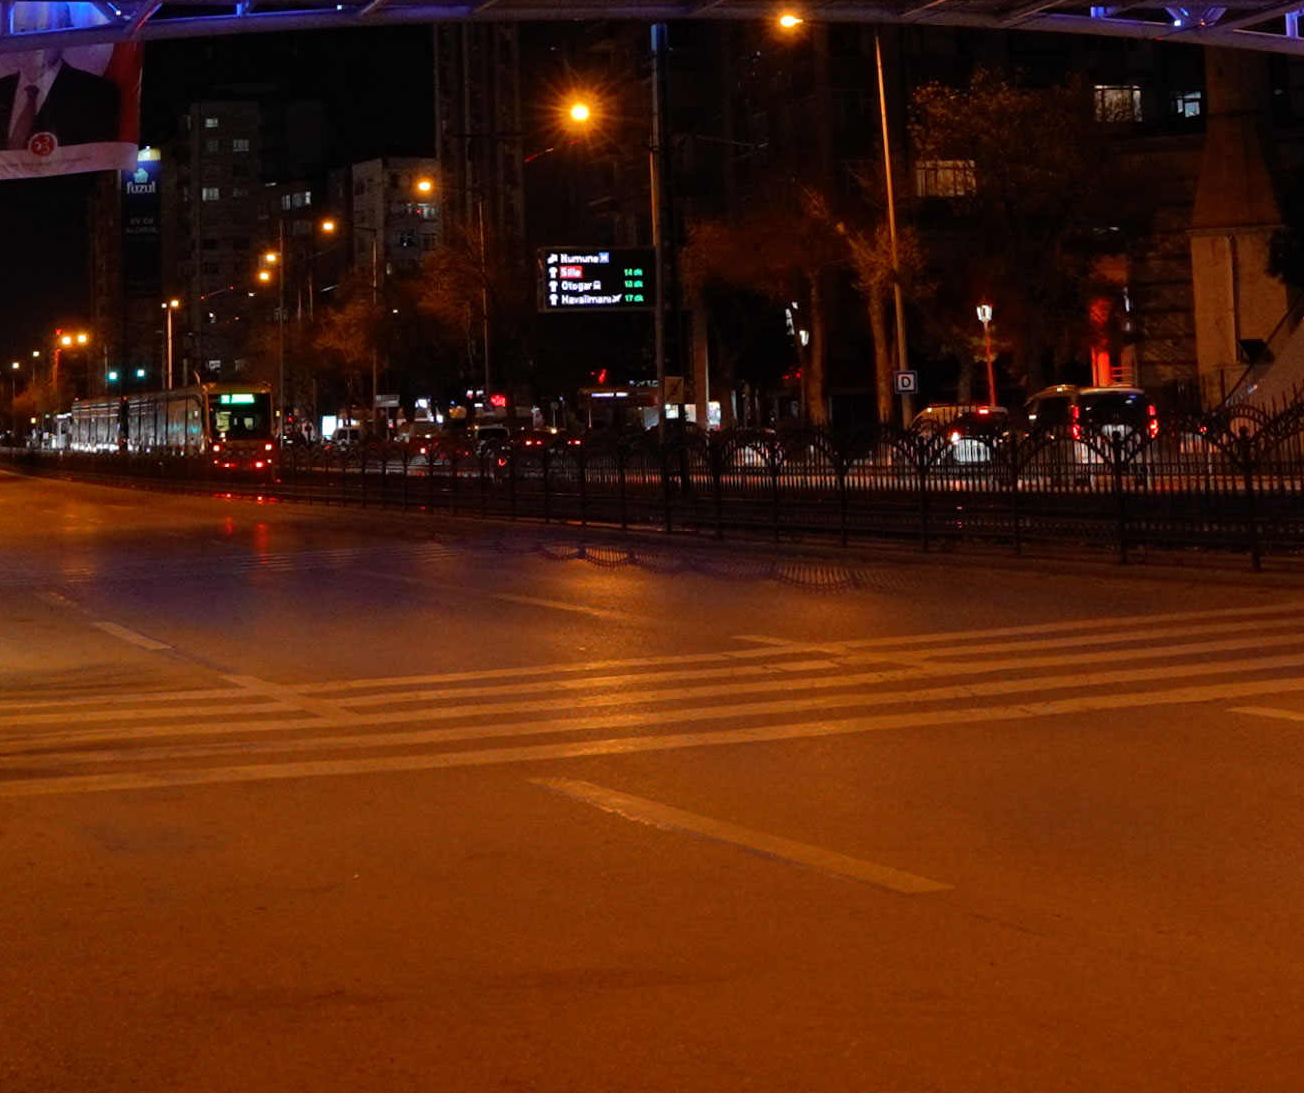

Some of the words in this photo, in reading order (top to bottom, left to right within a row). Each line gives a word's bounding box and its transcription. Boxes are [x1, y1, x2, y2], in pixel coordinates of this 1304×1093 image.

[126, 181, 156, 194] fuzul
[560, 253, 599, 263] Numune
[560, 267, 581, 277] Sille
[561, 281, 593, 292] Otogar
[561, 294, 612, 304] Havalimanı
[624, 294, 633, 302] 17
